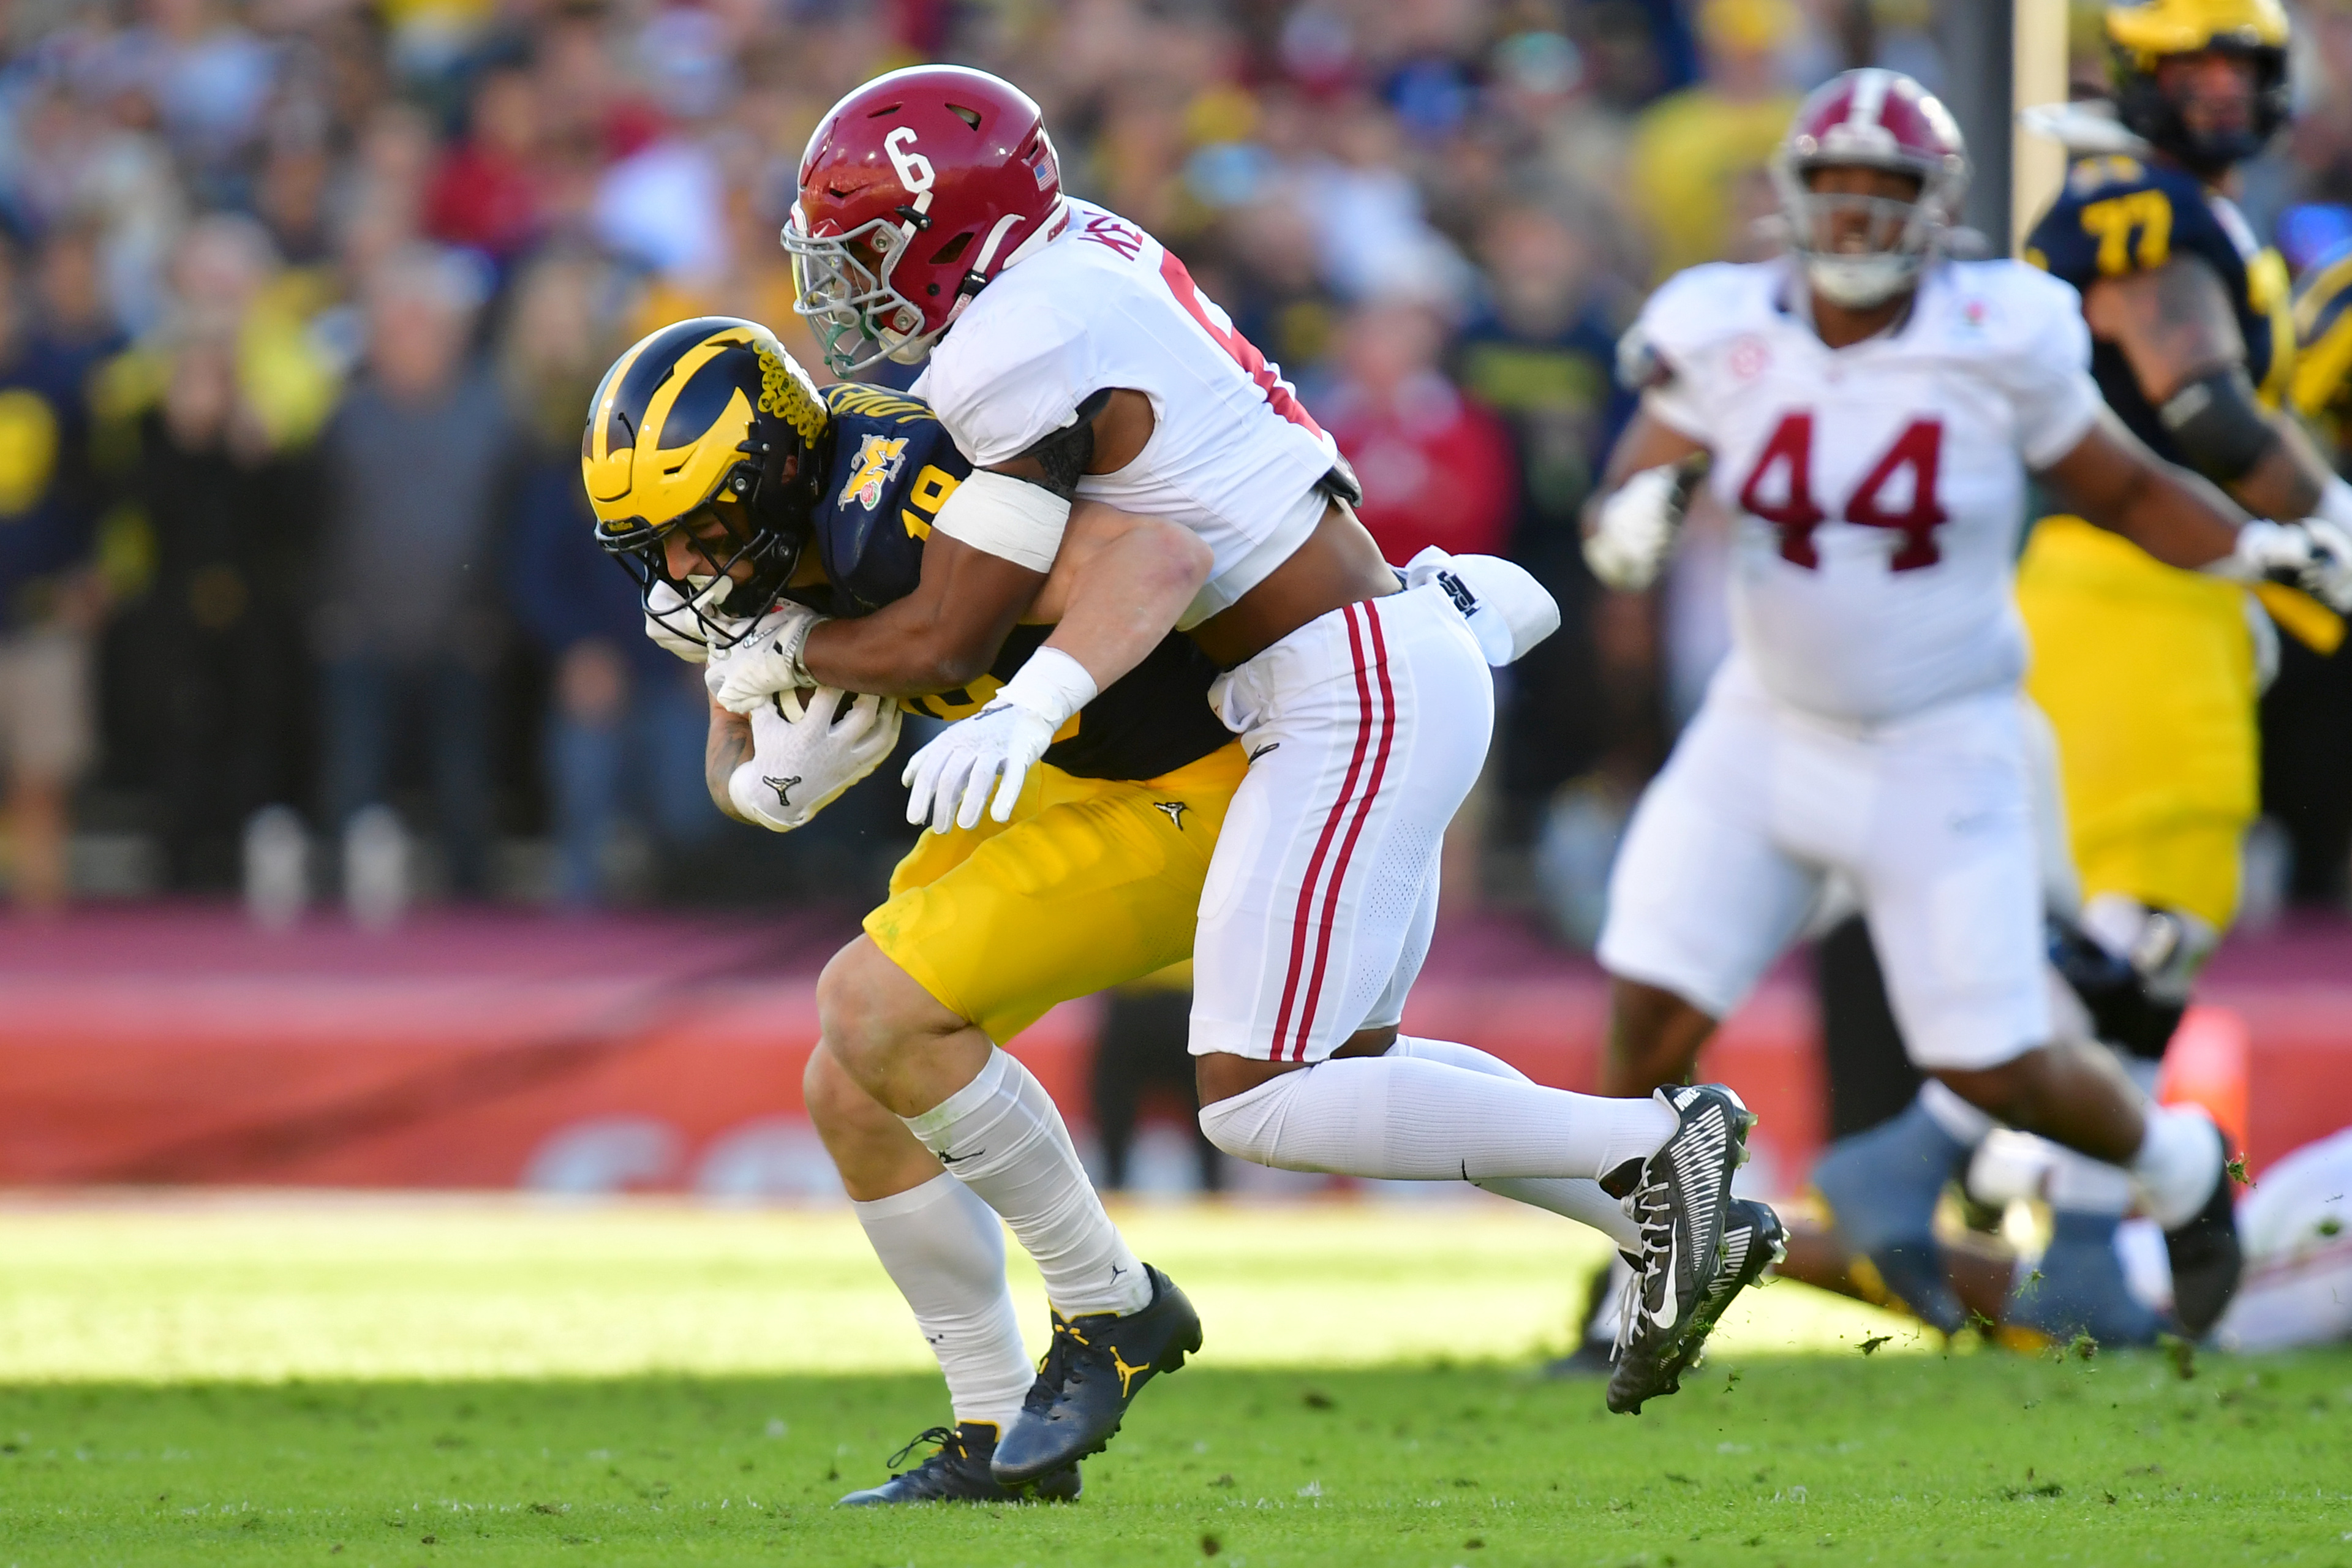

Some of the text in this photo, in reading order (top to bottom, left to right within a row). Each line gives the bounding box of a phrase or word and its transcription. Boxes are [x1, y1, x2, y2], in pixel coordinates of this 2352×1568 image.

[884, 126, 935, 194] 6
[2080, 190, 2174, 277] 77
[1741, 412, 1949, 572] 44
[1673, 1087, 1701, 1112] NIKE
